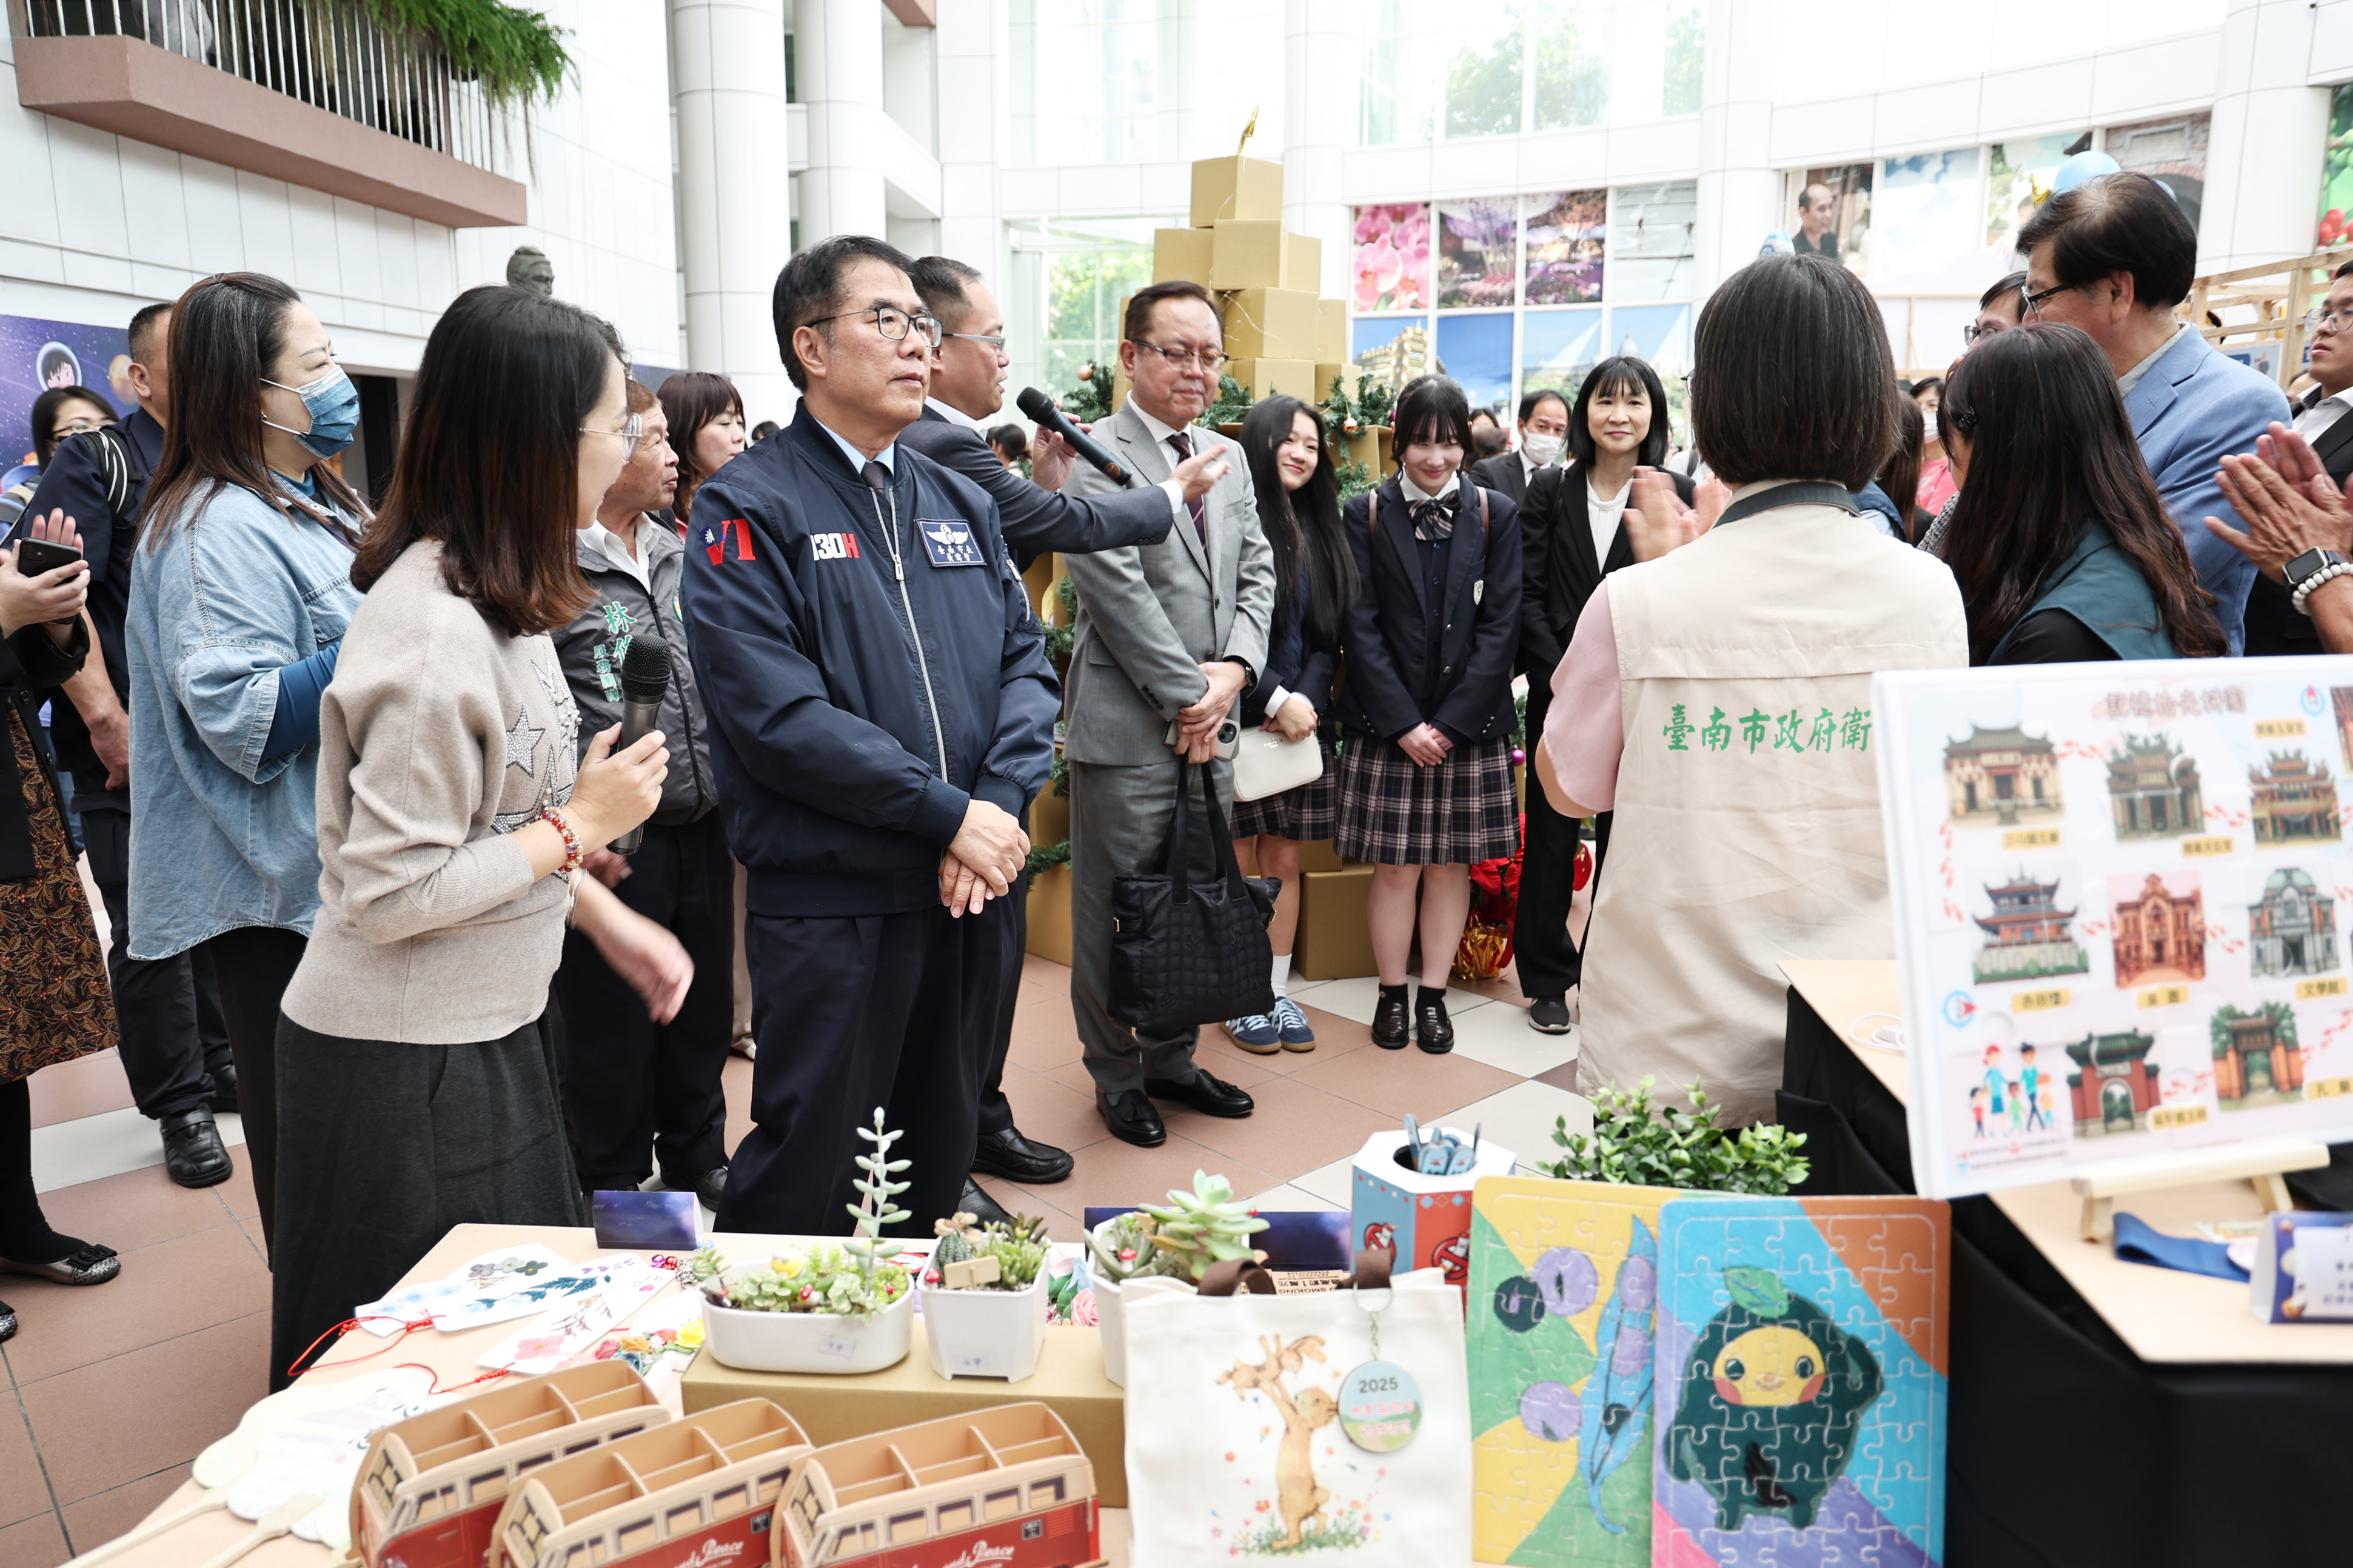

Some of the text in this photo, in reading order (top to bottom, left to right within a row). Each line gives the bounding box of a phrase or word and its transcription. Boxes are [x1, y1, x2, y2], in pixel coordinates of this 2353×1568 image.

[594, 644, 622, 702] 服務團隊
[1662, 703, 1873, 755] 臺南市政府衛
[1359, 1377, 1398, 1393] 2025
